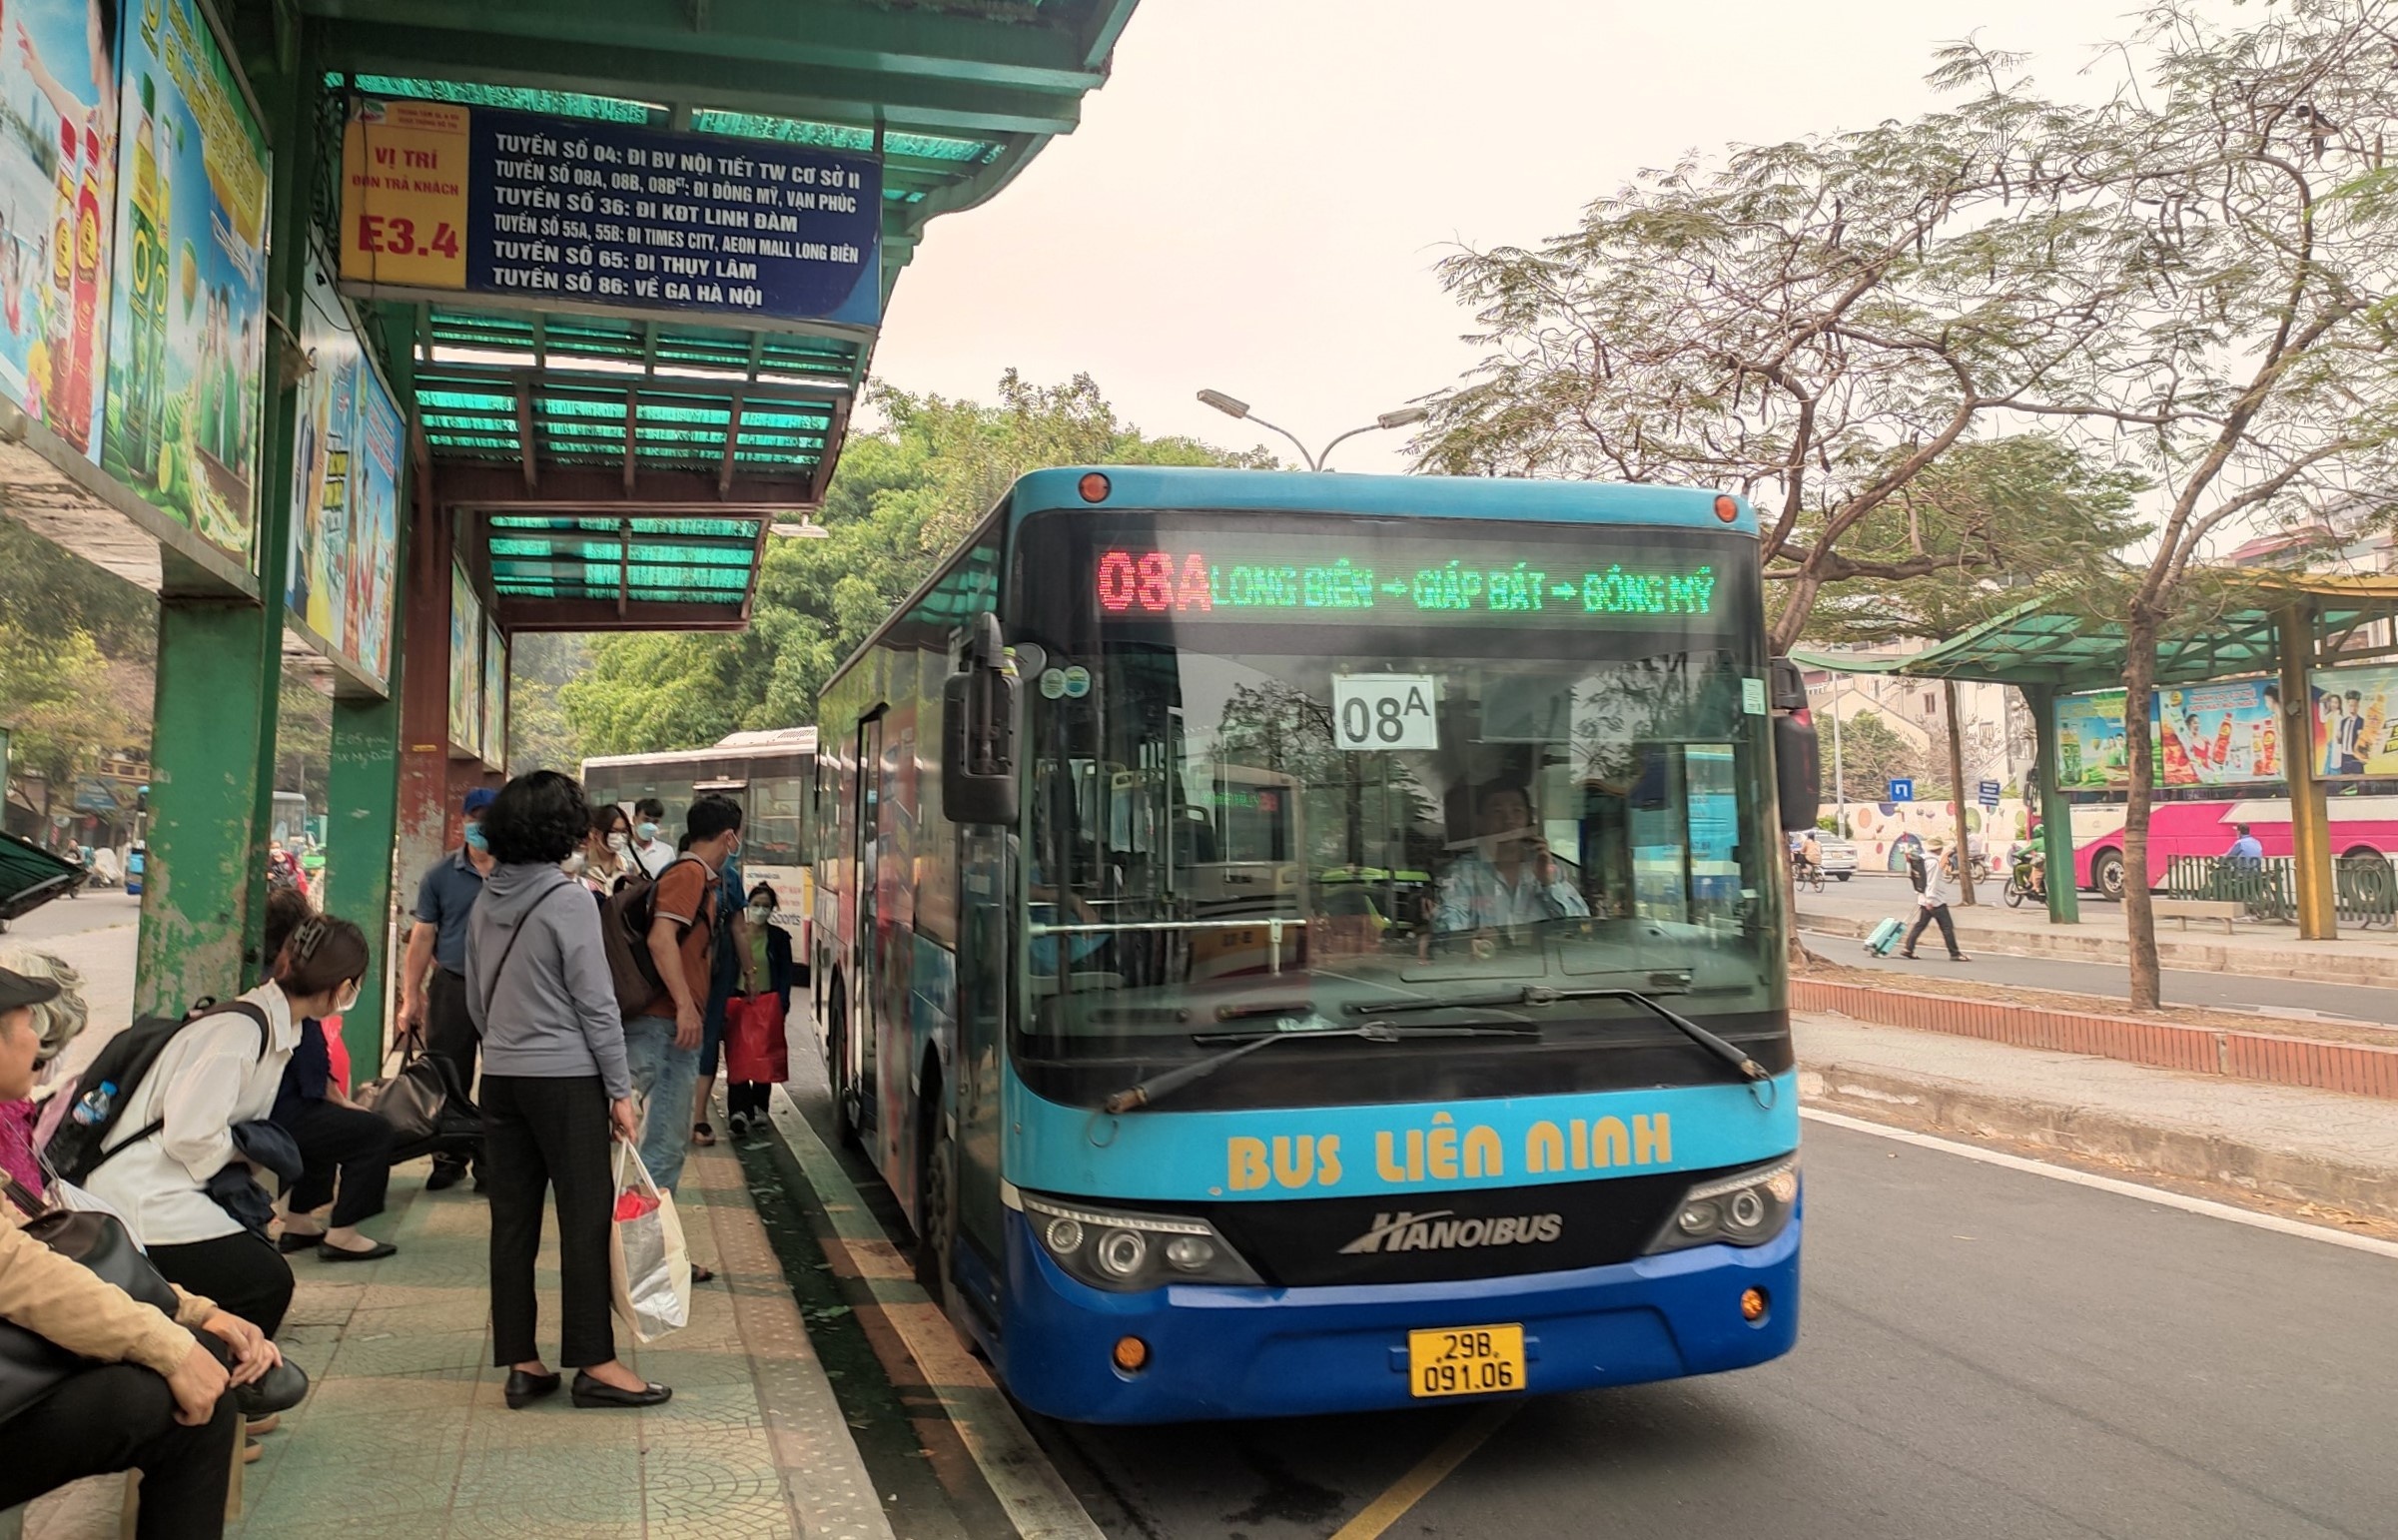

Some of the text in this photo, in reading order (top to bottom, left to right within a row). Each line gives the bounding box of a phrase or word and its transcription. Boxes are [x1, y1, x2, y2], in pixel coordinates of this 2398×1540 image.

[375, 146, 437, 170] VỊ TRÍ
[593, 145, 622, 164] 04:
[627, 148, 647, 167] ĐI
[651, 150, 676, 170] BV
[681, 153, 712, 177] NỘI
[717, 155, 755, 178] TIẾT
[758, 162, 787, 182] TW
[791, 167, 816, 185] CƠ
[820, 164, 845, 189] SỞ
[848, 172, 861, 190] II
[413, 179, 459, 197] KHÁCH
[574, 168, 607, 190] 08A,
[611, 173, 644, 194] 08B,
[693, 181, 709, 199] ĐI
[712, 181, 752, 203] ĐÔNG
[756, 186, 783, 209] MỸ,
[786, 190, 815, 212] VẠN
[819, 191, 857, 214] PHÚC
[599, 197, 630, 217] 36:
[635, 200, 656, 219] ĐI
[662, 203, 700, 224] KĐT
[704, 208, 749, 229] LINH
[754, 211, 798, 233] ĐÀM
[359, 215, 459, 259] E3.4
[562, 221, 592, 241] 55A,
[595, 224, 624, 243] 55B:
[627, 227, 641, 245] ĐI
[644, 228, 684, 249] TIMES
[687, 233, 719, 253] CITY,
[722, 236, 756, 256] AEON
[759, 238, 793, 259] MALL
[796, 242, 828, 261] LONG
[830, 243, 859, 264] BIÊN
[599, 251, 630, 269] 65:
[634, 253, 655, 272] ĐI
[660, 256, 710, 280] THỤY
[715, 258, 758, 281] LÂM
[598, 277, 629, 296] 86:
[634, 275, 659, 298] VỀ
[664, 282, 692, 301] GA
[697, 283, 724, 304] HÀ
[728, 285, 763, 309] NỘI
[1099, 551, 1211, 611] 08A
[1210, 564, 1297, 606] LONG
[1412, 559, 1483, 610] GIÁP
[1488, 561, 1546, 610] BÁT
[1342, 684, 1430, 744] 08A
[1227, 1111, 1673, 1191] BUS LIÊN NINH
[1442, 1331, 1491, 1360] 29B
[1424, 1361, 1513, 1392] 091.06
